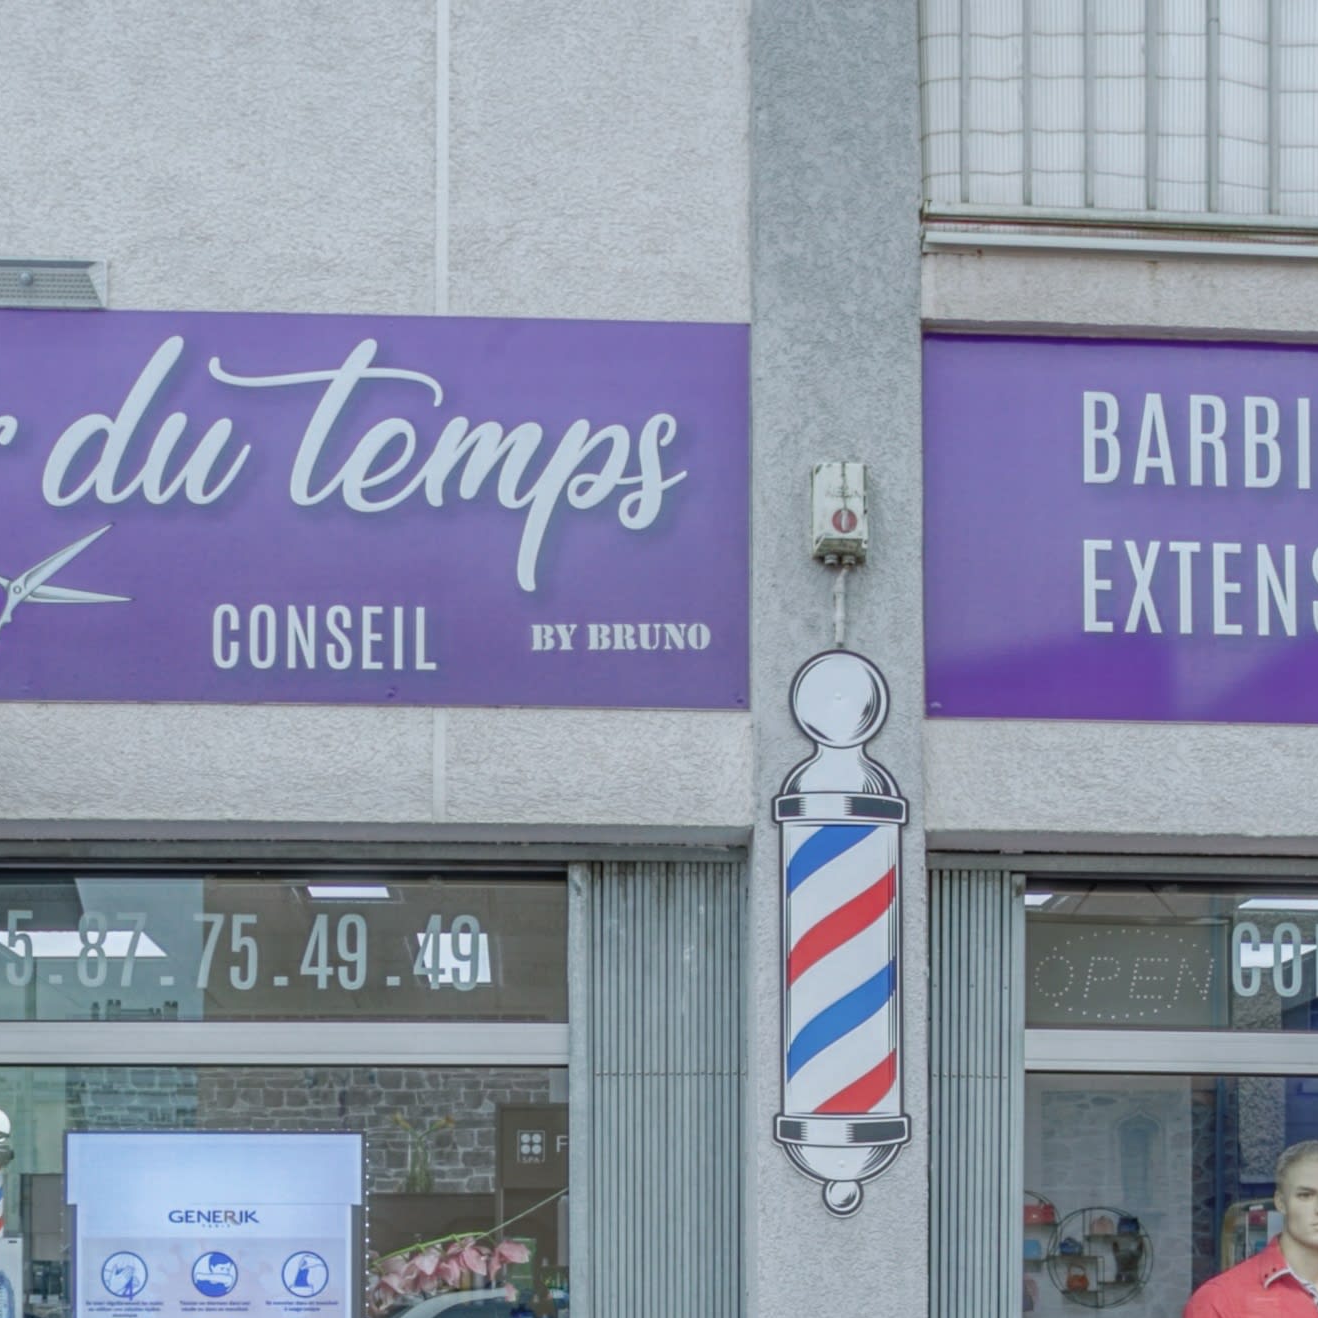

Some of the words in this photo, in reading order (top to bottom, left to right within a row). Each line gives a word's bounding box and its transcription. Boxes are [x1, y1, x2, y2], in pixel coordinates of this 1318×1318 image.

[41, 335, 251, 507] du
[209, 338, 687, 592] temps
[211, 603, 438, 672] CONSEIL
[530, 623, 578, 653] BY
[586, 622, 713, 652] BRUNO
[1033, 953, 1216, 1002] OPEN
[168, 1209, 260, 1225] GENERIK
